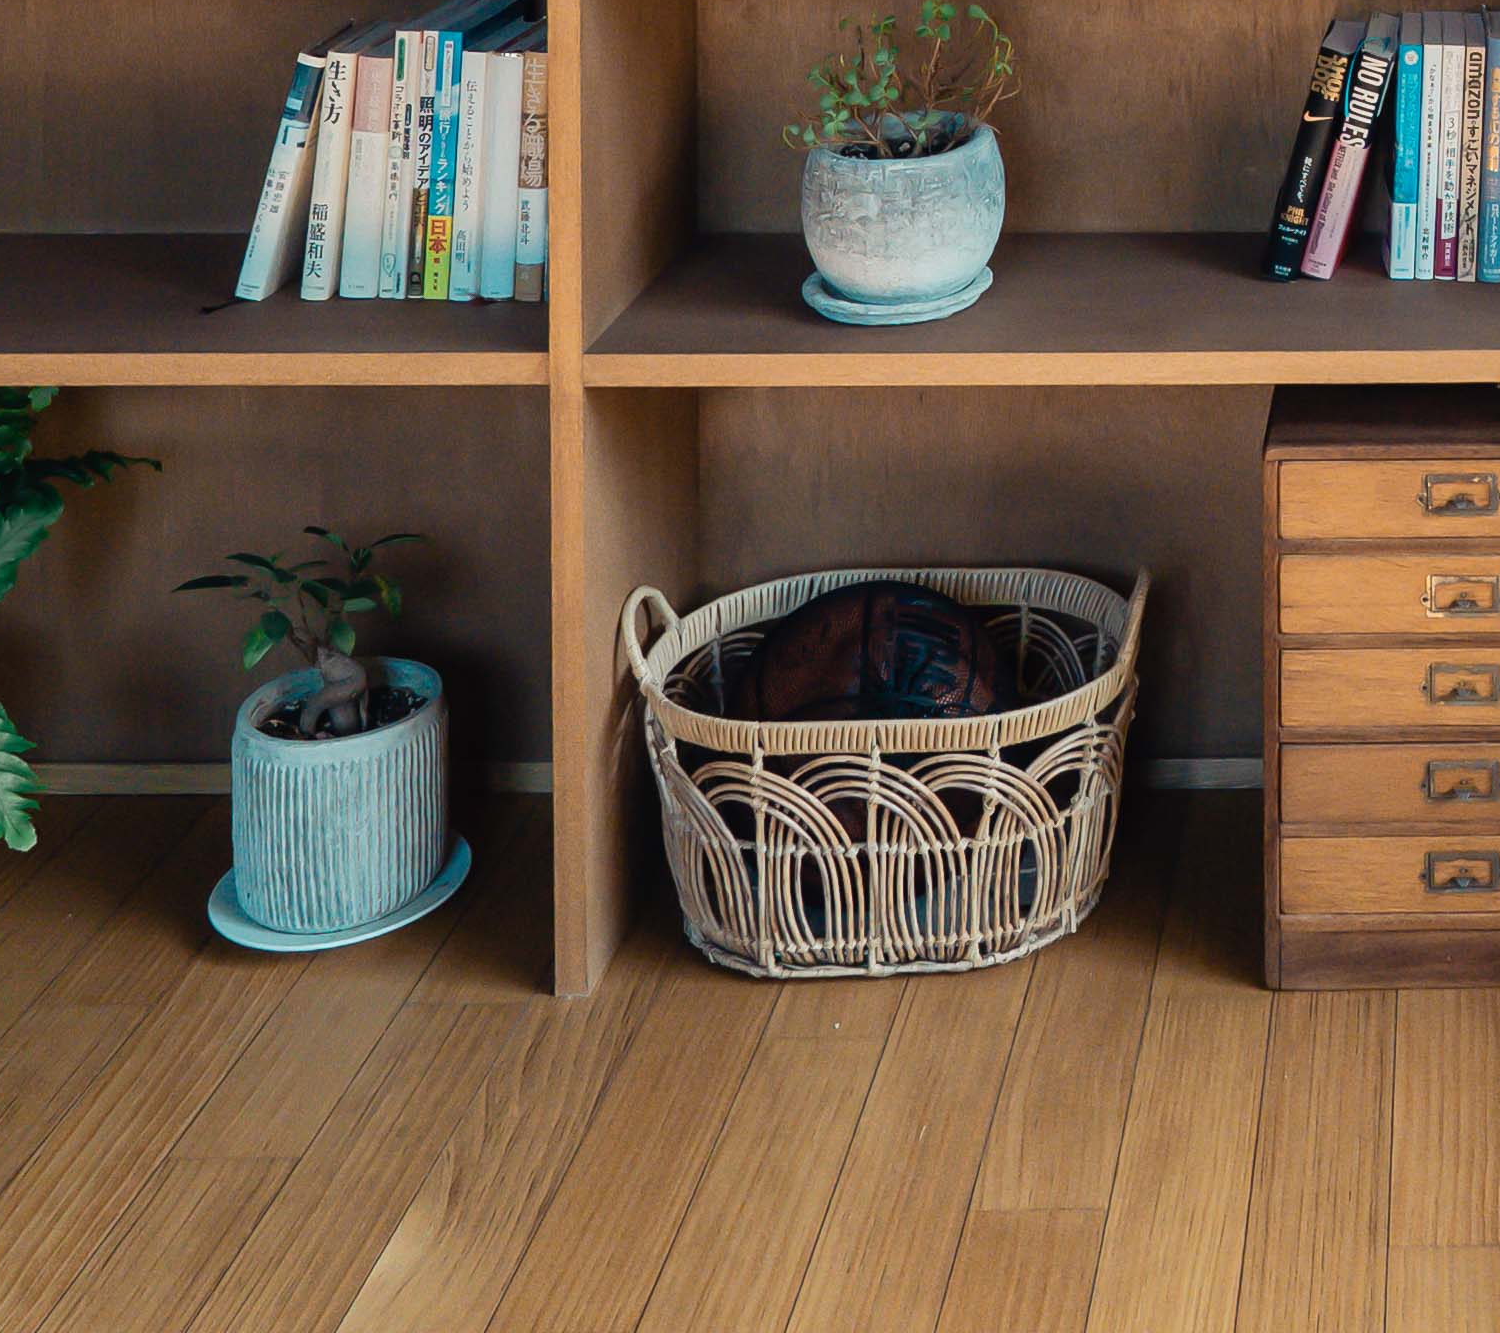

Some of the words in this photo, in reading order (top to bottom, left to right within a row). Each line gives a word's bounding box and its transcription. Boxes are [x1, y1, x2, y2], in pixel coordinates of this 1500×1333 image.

[323, 60, 347, 125] 生き方
[1312, 54, 1329, 94] DOG
[1323, 56, 1348, 102] SHOE
[1357, 52, 1389, 87] NO
[1338, 86, 1379, 149] RULES
[462, 80, 477, 212] 伝えることから始めよう
[305, 203, 330, 279] 稲盛和夫
[429, 220, 447, 254] 日本
